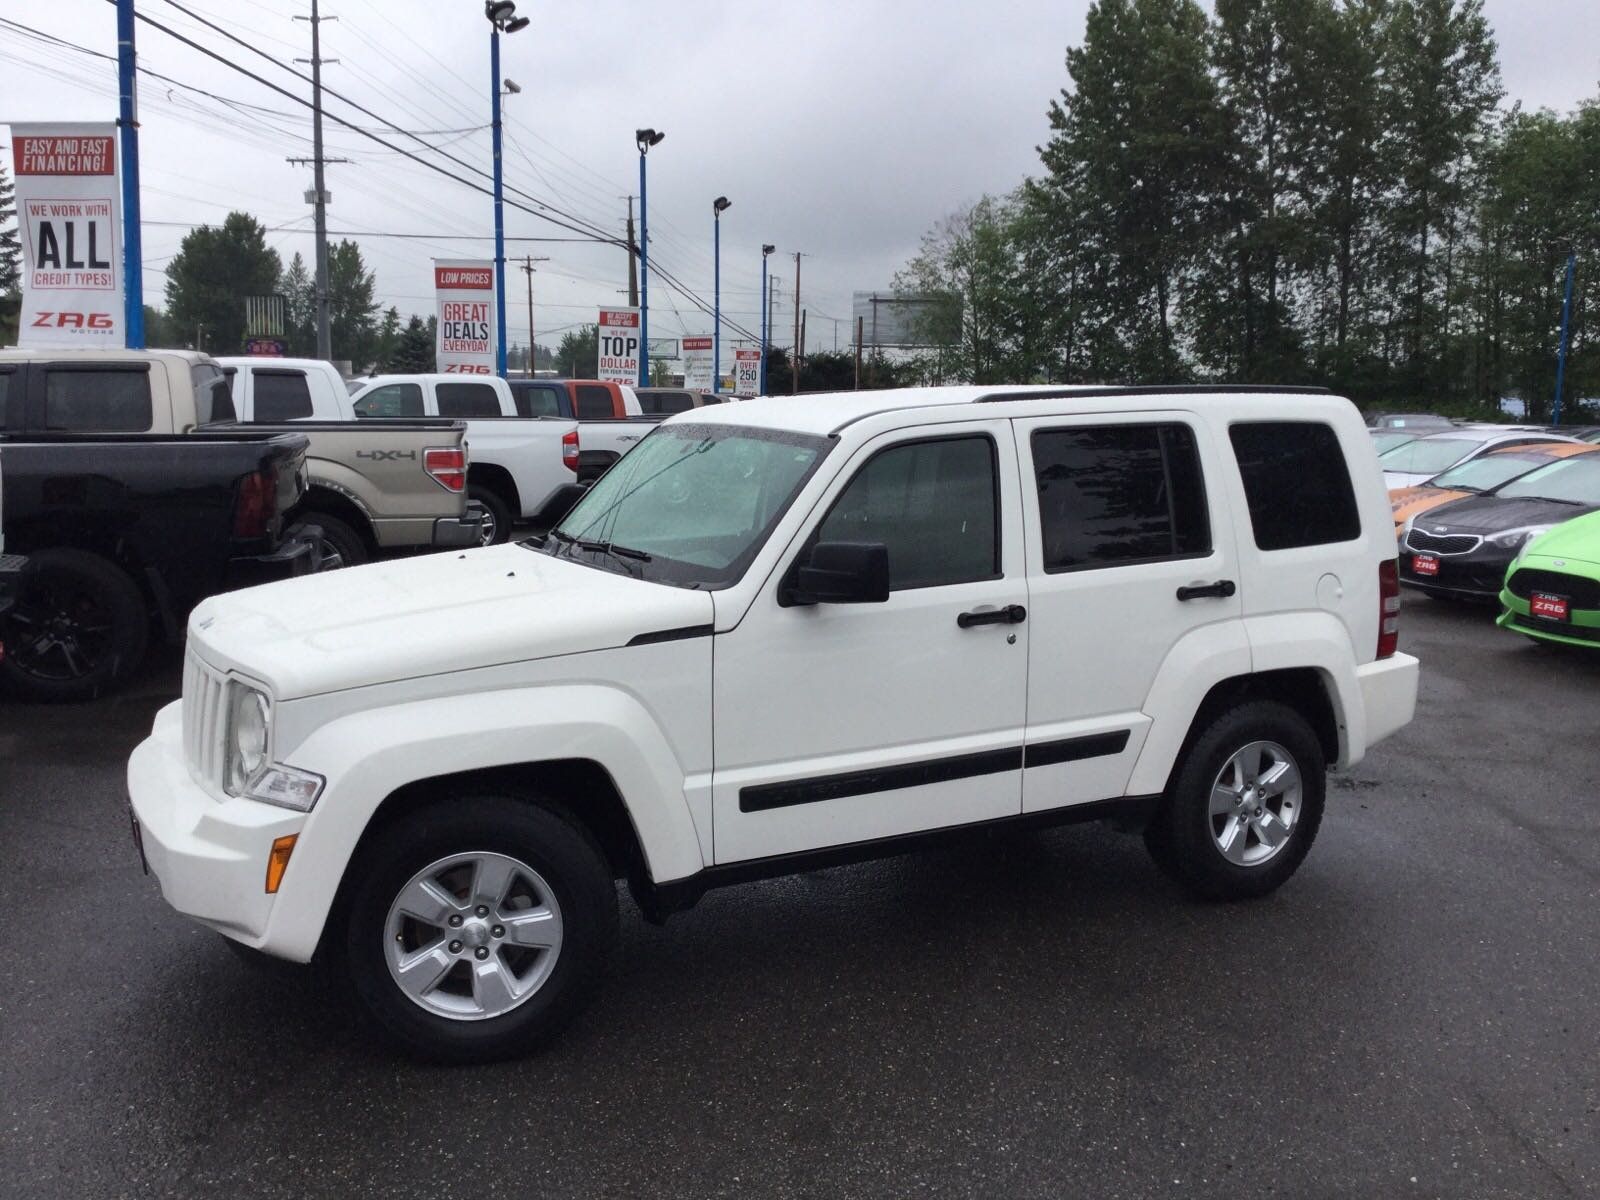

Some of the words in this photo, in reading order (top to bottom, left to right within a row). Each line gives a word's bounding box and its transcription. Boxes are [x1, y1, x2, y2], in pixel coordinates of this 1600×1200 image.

[24, 139, 52, 155] EASY
[55, 139, 79, 155] AND
[81, 139, 108, 154] FAST
[23, 155, 106, 172] FINANCING!
[30, 204, 48, 216] WE
[50, 205, 82, 217] WORK
[85, 205, 108, 216] WITH
[37, 221, 110, 269] ALL
[35, 273, 71, 286] CREDIT
[74, 273, 112, 286] TYPES!
[441, 272, 459, 284] LOW
[460, 273, 490, 284] PRICES
[444, 303, 488, 322] GREAT
[31, 312, 114, 328] ZAG
[444, 322, 488, 340] DEALS
[443, 340, 488, 352] EVERYDAY
[601, 337, 637, 357] TOP
[445, 364, 491, 374] ZAG
[600, 358, 636, 369] DOLLAR
[740, 361, 757, 369] OVER
[740, 370, 757, 380] 250
[1416, 561, 1437, 570] ZAG
[1537, 593, 1559, 601] ZAG
[1534, 601, 1565, 613] ZAG
